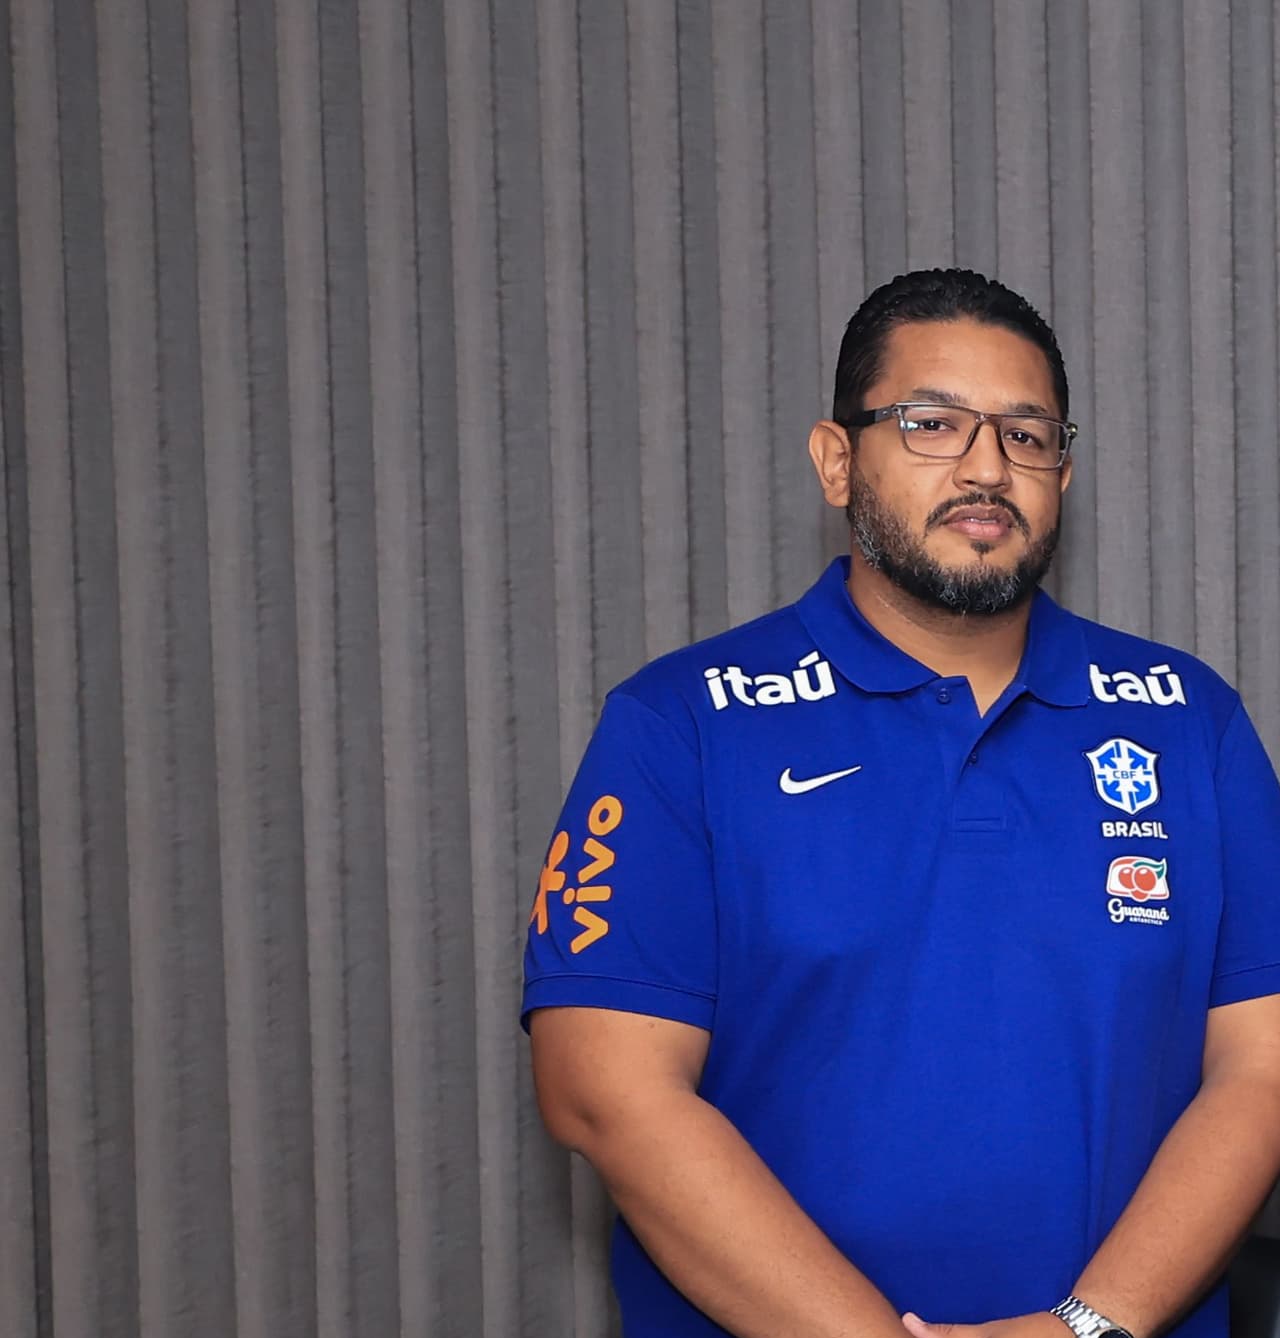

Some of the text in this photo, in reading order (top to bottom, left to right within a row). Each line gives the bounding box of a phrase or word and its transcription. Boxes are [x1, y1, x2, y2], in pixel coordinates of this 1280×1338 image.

[704, 650, 836, 711] itaú
[1088, 663, 1187, 706] taú
[1112, 769, 1138, 780] CBF
[1102, 821, 1168, 839] BRASIL
[563, 795, 624, 954] vivo
[1107, 898, 1170, 924] Guaraná
